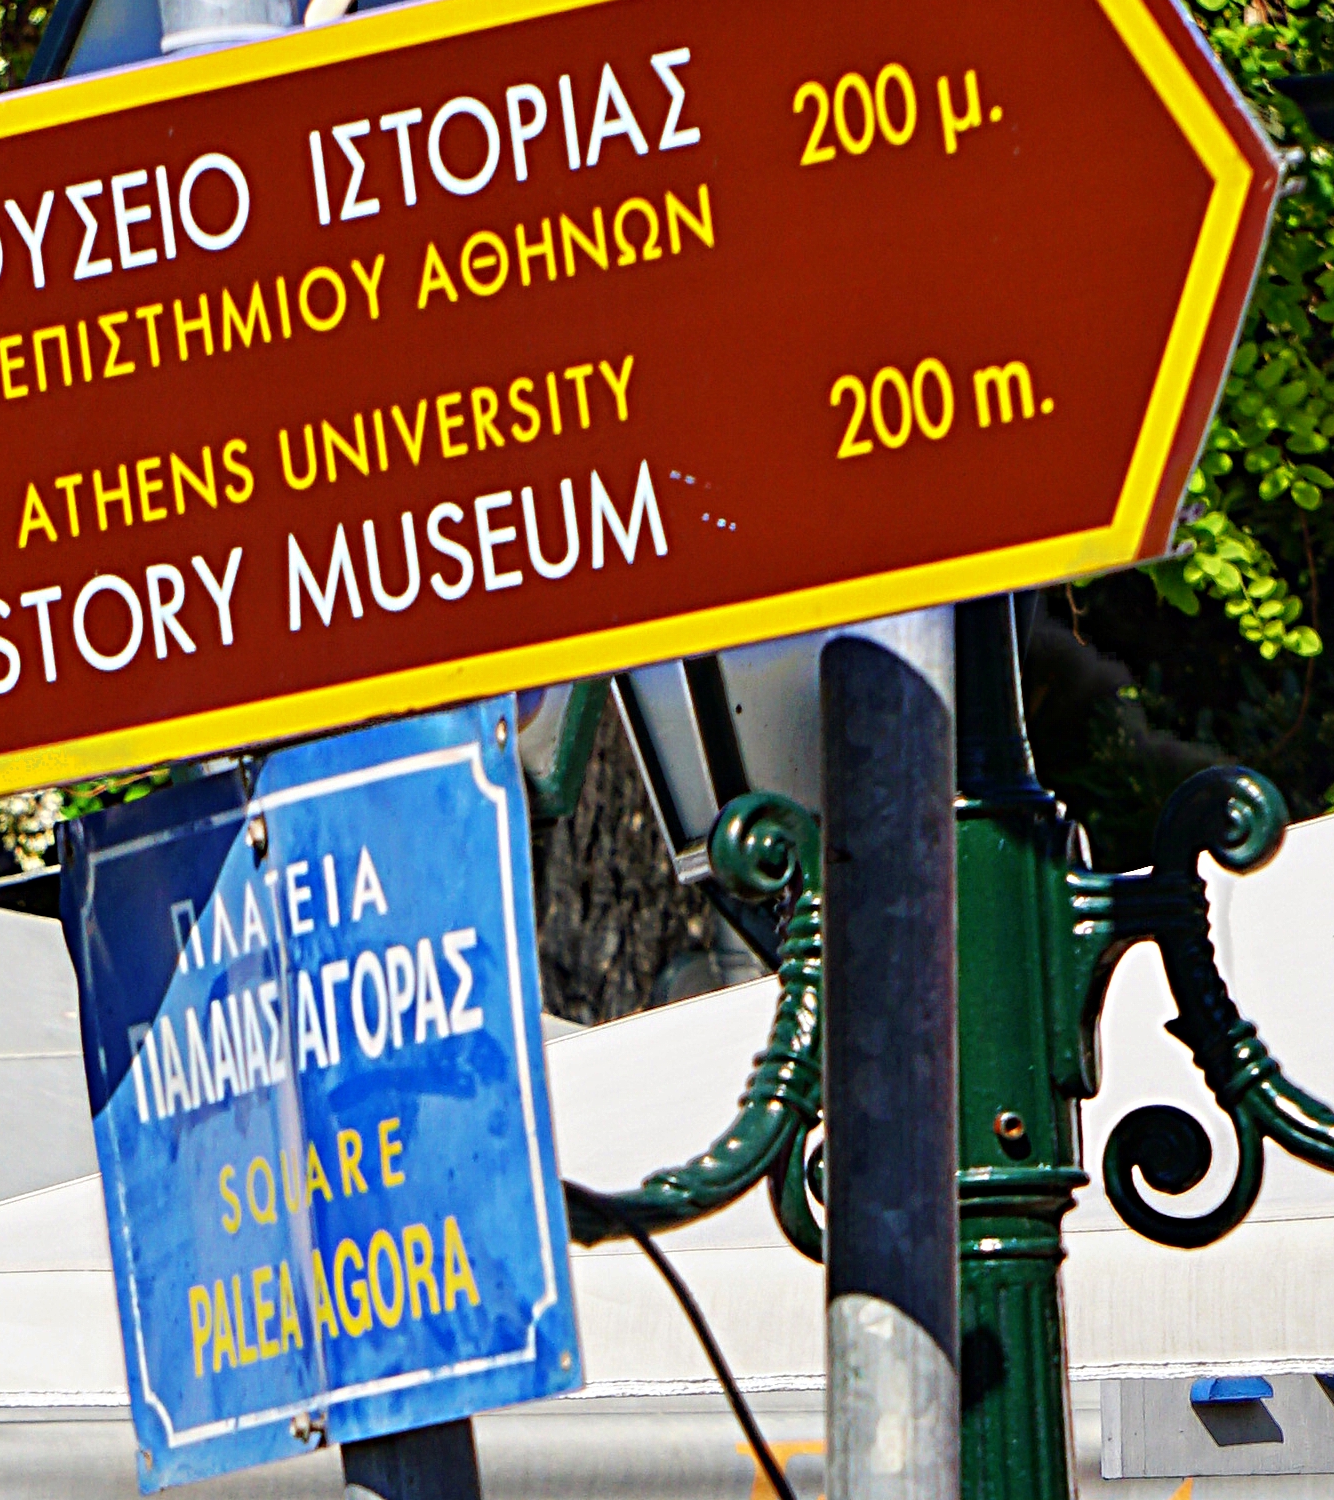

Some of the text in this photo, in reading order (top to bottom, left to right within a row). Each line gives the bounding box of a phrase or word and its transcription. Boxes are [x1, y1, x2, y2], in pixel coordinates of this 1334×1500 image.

[307, 46, 702, 227] ΙΣΤΟΡΙΑΣ
[793, 62, 1004, 167] 200 μ.
[416, 183, 715, 311] ΑΘΗΝΩΝ
[17, 438, 255, 550] ATHENS
[278, 354, 635, 493] UNIVERSITY
[829, 357, 1055, 460] 200 m.
[286, 458, 670, 633] MUSEUM
[170, 844, 389, 975] ΠΛΑΤΕΙΑ
[127, 927, 484, 1125] ΠΑΛΑΙΑΣ ΑΓΟΡΑΣ
[218, 1116, 406, 1235] SQUARE
[187, 1215, 481, 1379] PALEA AGORA
